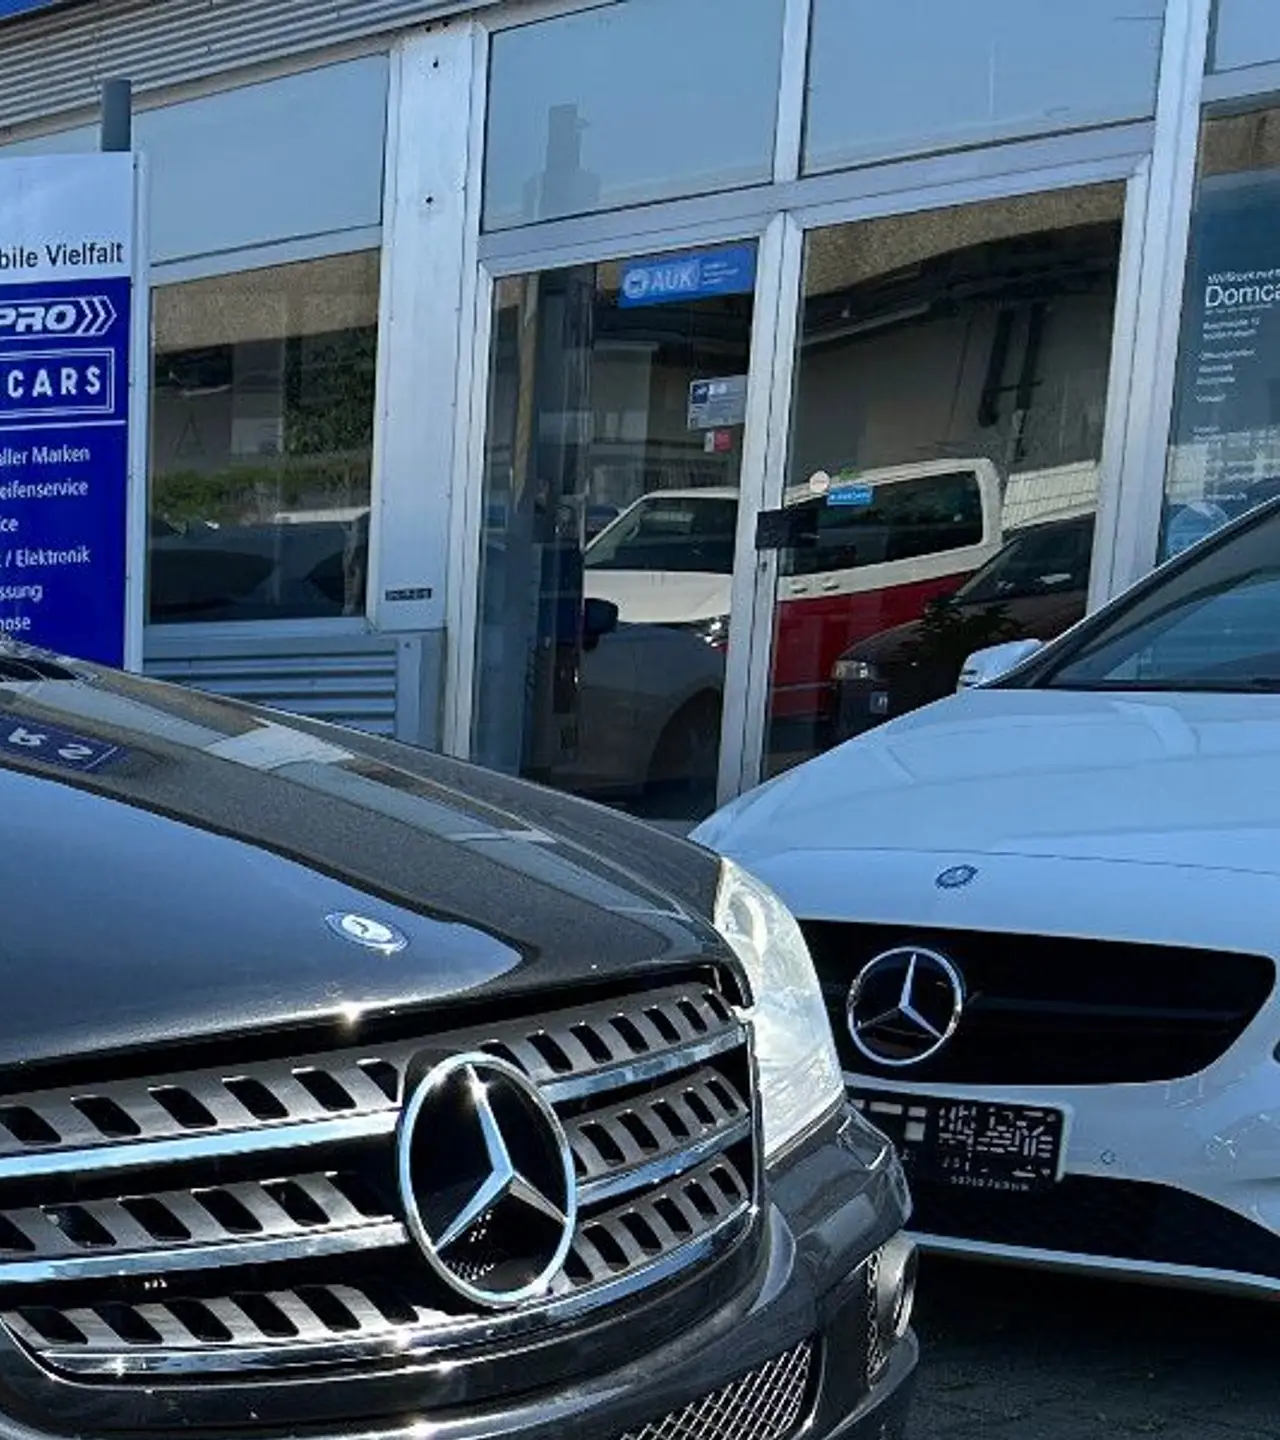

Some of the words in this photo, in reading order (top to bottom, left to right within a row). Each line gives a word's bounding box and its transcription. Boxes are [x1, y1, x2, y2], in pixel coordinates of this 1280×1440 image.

[44, 242, 125, 267] Vielfalt
[32, 444, 91, 465] Marken
[15, 545, 91, 568] Elektronik
